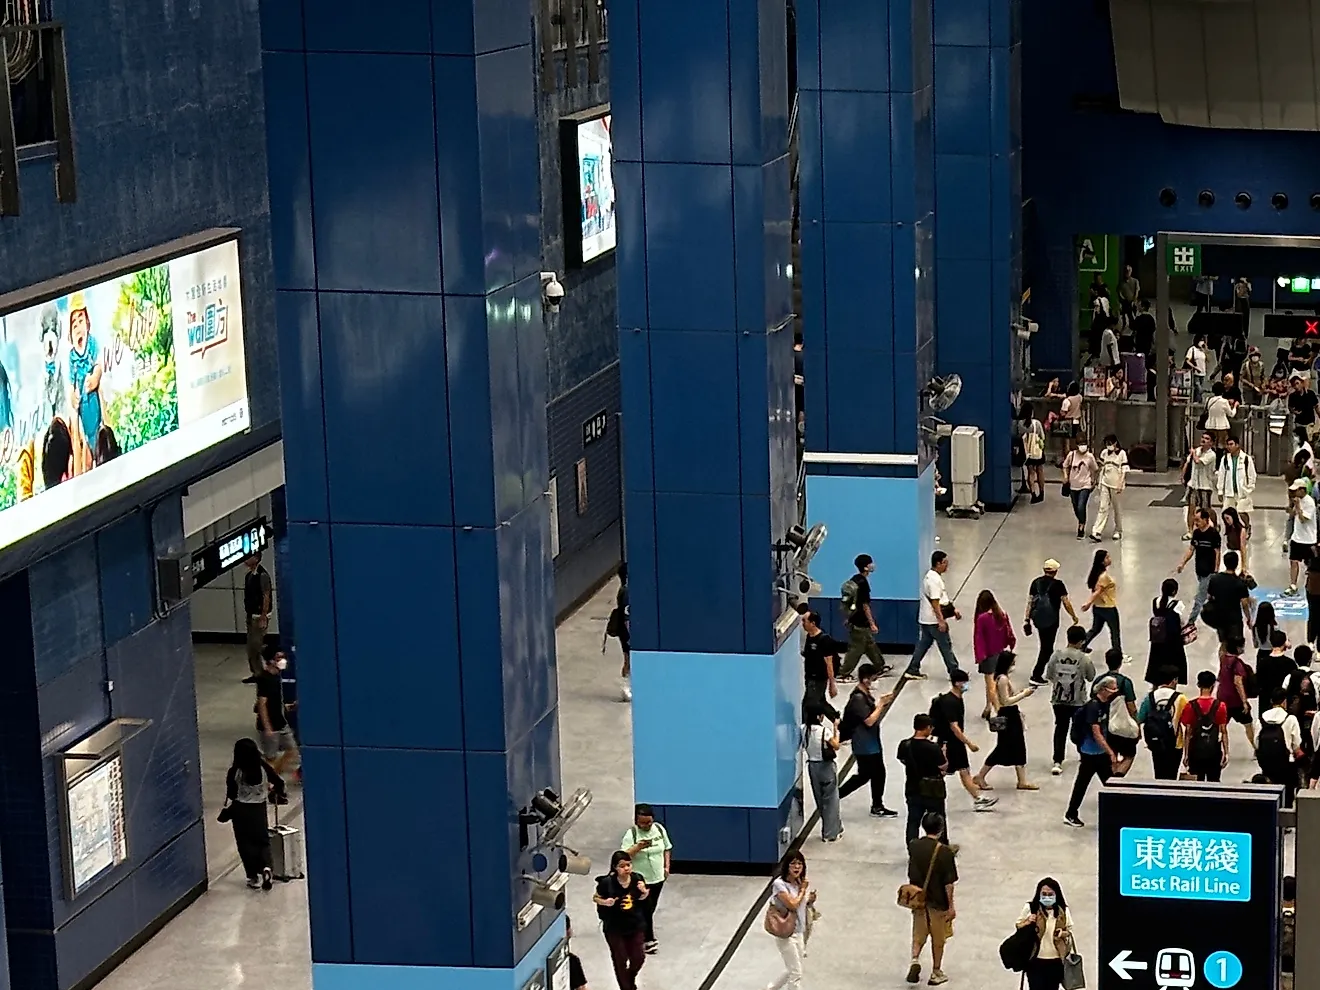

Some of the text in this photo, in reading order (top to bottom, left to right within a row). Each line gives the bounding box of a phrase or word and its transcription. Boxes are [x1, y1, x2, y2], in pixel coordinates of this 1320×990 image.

[1174, 265, 1194, 273] EXIT
[1133, 836, 1239, 874] 東鐵綫
[1130, 874, 1241, 895] East Rail Line
[1215, 957, 1229, 982] 1
